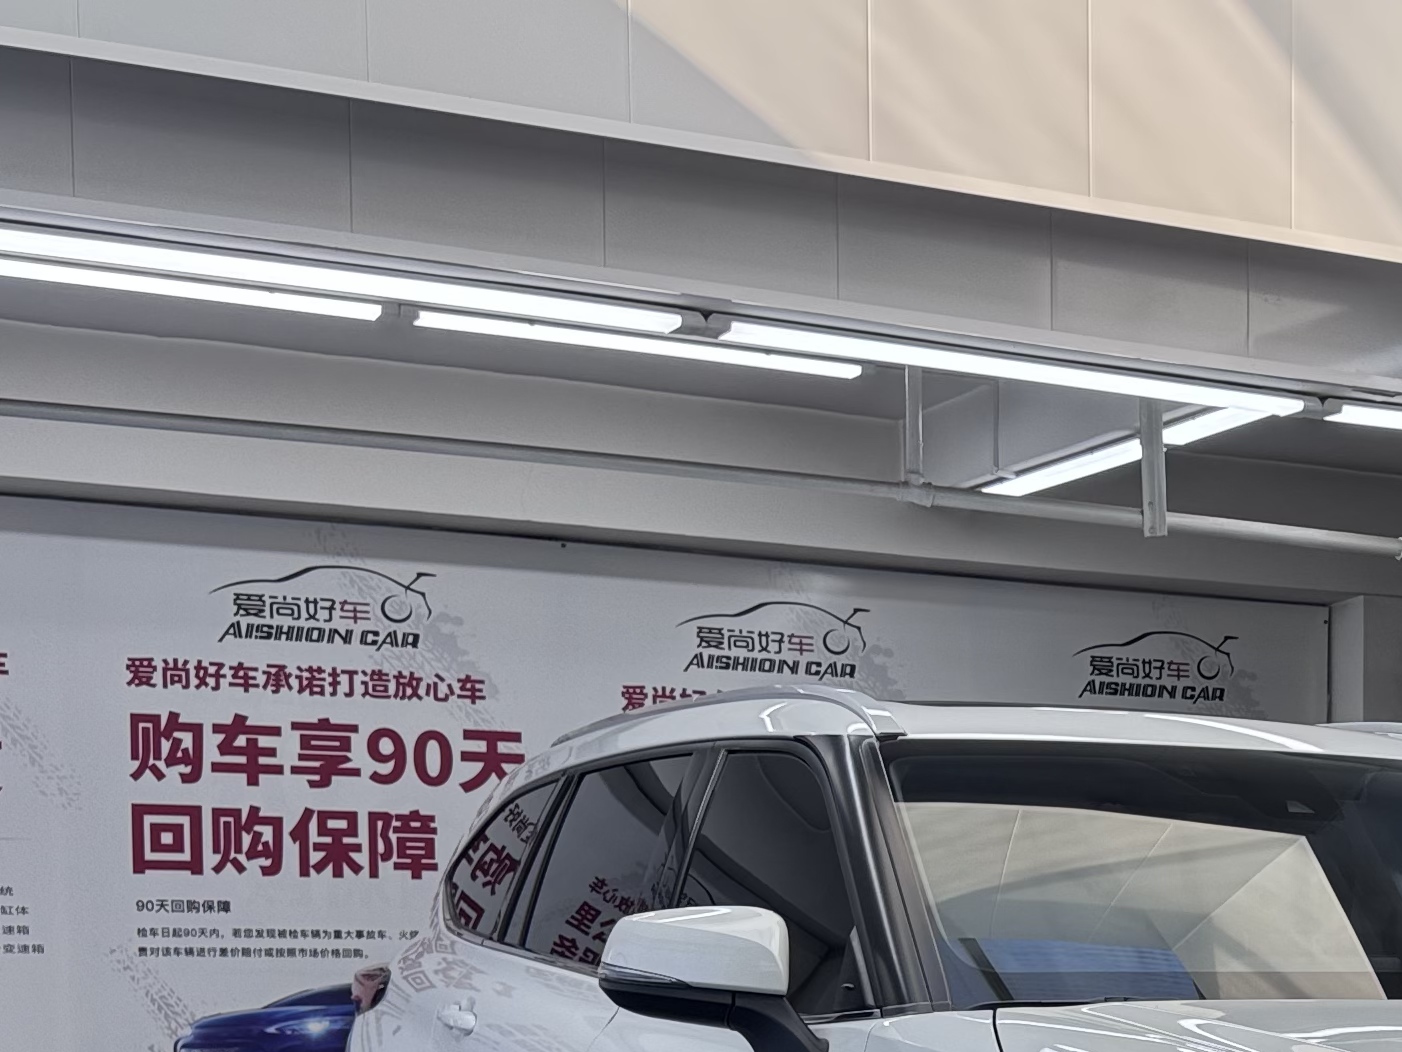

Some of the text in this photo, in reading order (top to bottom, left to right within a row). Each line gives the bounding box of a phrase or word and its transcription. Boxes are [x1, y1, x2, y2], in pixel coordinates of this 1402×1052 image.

[232, 592, 372, 624] 爱尚好车
[218, 620, 421, 652] AISHION CAR
[696, 626, 815, 656] 爱尚好车
[125, 655, 487, 705] 爱尚好车承诺打造放心车
[683, 651, 857, 682] AISHION CAR
[1090, 655, 1191, 681] 爱尚好车
[1078, 679, 1226, 705] AISHION CAR
[128, 710, 526, 793] 购车享90天
[131, 803, 439, 880] 回购保障
[136, 899, 232, 914] 90天回购保障
